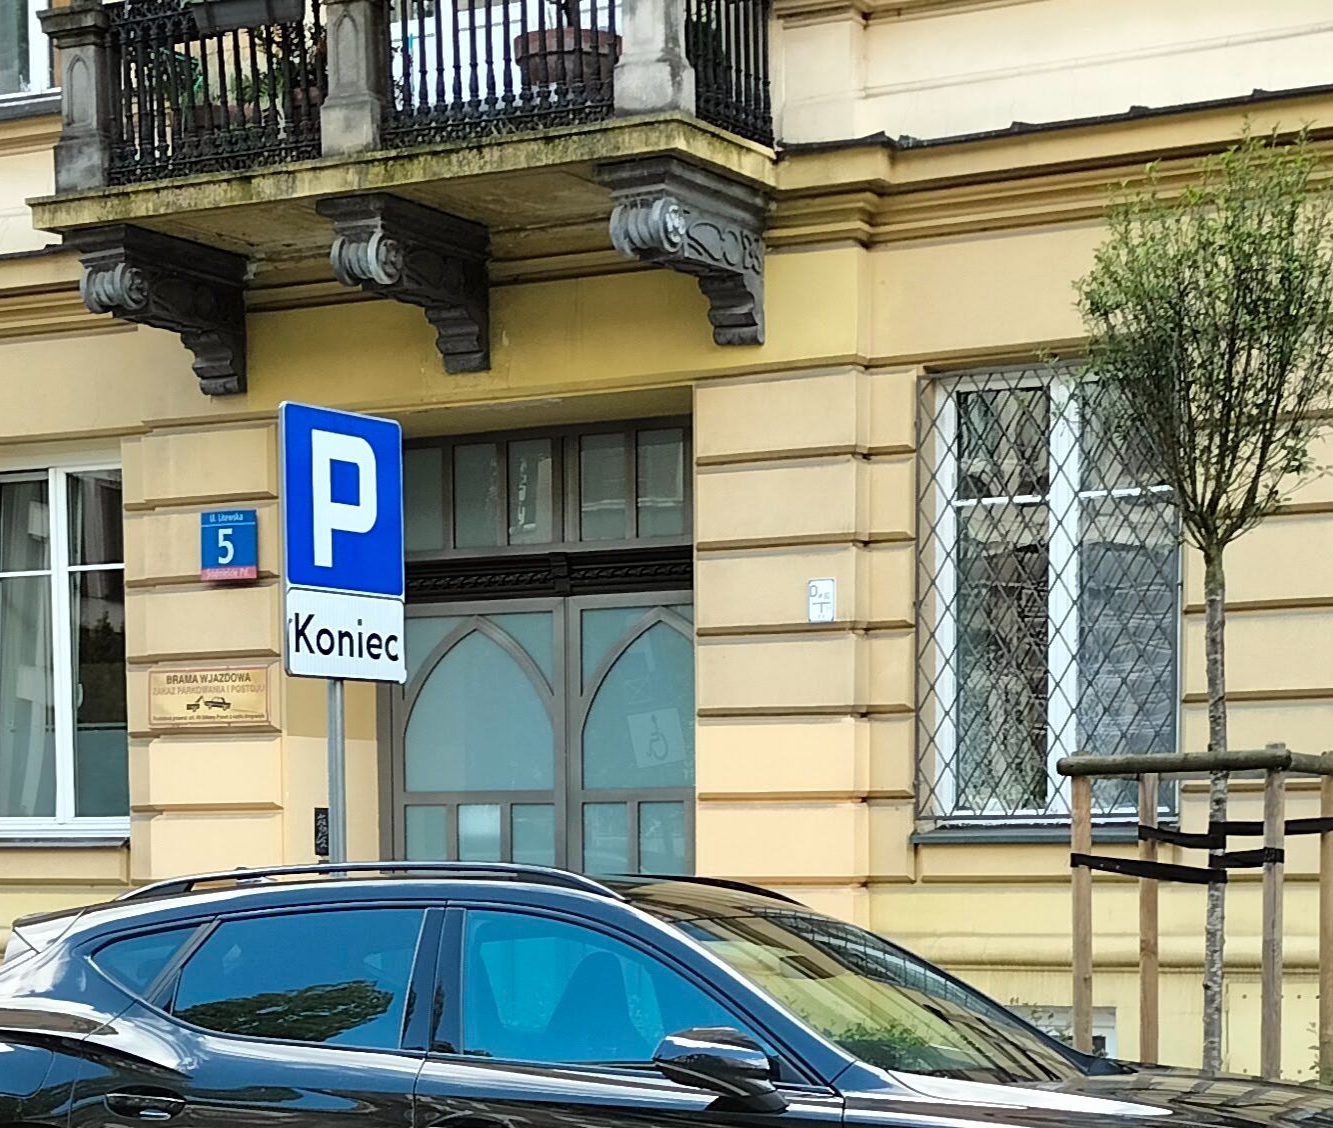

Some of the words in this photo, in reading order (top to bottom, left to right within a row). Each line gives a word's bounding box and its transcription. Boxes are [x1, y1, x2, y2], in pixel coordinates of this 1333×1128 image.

[311, 428, 377, 568] P
[218, 528, 234, 564] 5
[294, 612, 399, 661] Koniec
[166, 674, 198, 685] BRAMA
[200, 672, 252, 683] WJAZDOWA
